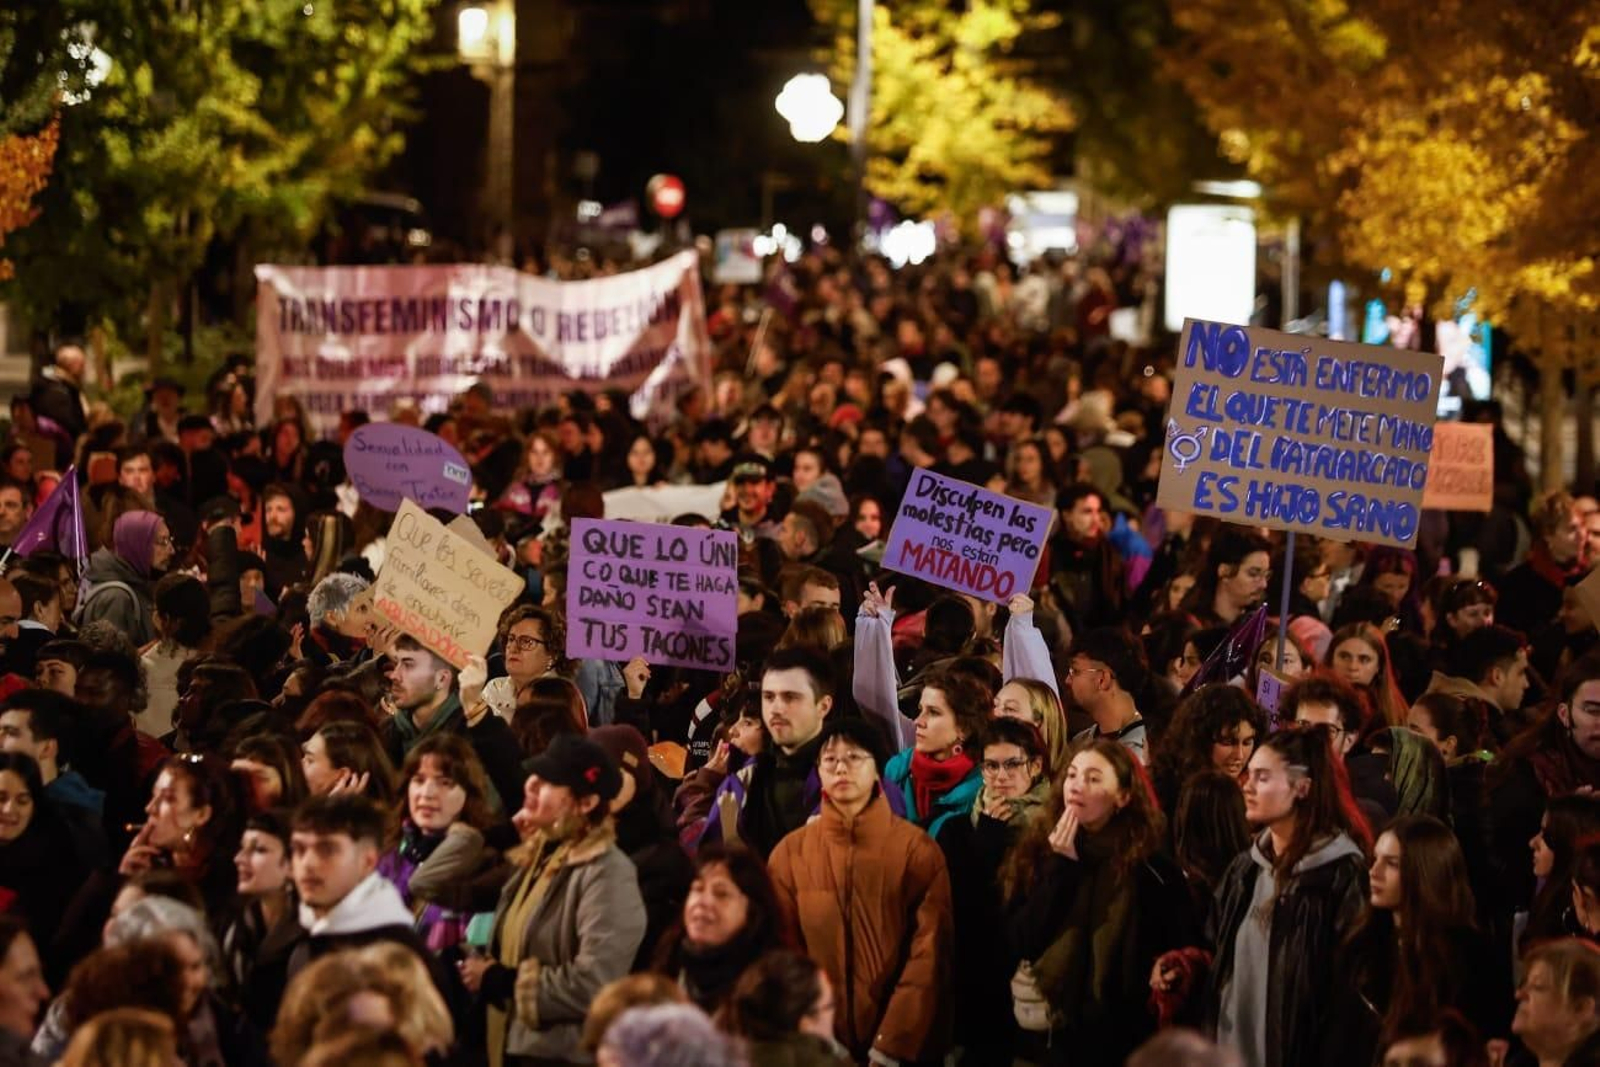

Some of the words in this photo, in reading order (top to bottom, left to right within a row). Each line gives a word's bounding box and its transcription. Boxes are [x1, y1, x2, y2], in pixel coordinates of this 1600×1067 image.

[531, 305, 545, 337] O
[1184, 321, 1251, 379] NO
[1250, 346, 1312, 387] ESTÁ
[1314, 356, 1432, 403] ENFERMO
[1186, 382, 1224, 423] EL
[1224, 389, 1275, 430] QUE
[1276, 398, 1315, 436] TE
[1315, 406, 1376, 444] METE
[1376, 414, 1433, 452] MANO
[1210, 428, 1265, 470] DEL
[1271, 435, 1429, 491] PATRIARCADO
[915, 474, 1005, 520] Disculpen
[1008, 504, 1037, 533] las
[1193, 471, 1241, 513] ES
[1245, 479, 1320, 525] HIJO
[1322, 490, 1419, 542] SANO
[397, 512, 432, 549] Que
[582, 528, 645, 559] QUE
[655, 537, 689, 562] LO
[700, 533, 736, 569] ÚNI
[902, 503, 995, 546] molestias
[997, 531, 1039, 560] pero
[931, 535, 954, 551] nos
[583, 560, 613, 582] CO
[619, 564, 659, 588] QUE
[665, 571, 691, 592] TE
[695, 573, 735, 595] HAGA
[899, 539, 1015, 599] MATANDO
[579, 583, 636, 610] DAÑO
[646, 594, 705, 622] SEAN
[578, 618, 628, 651] TUS
[640, 626, 731, 666] TACONES
